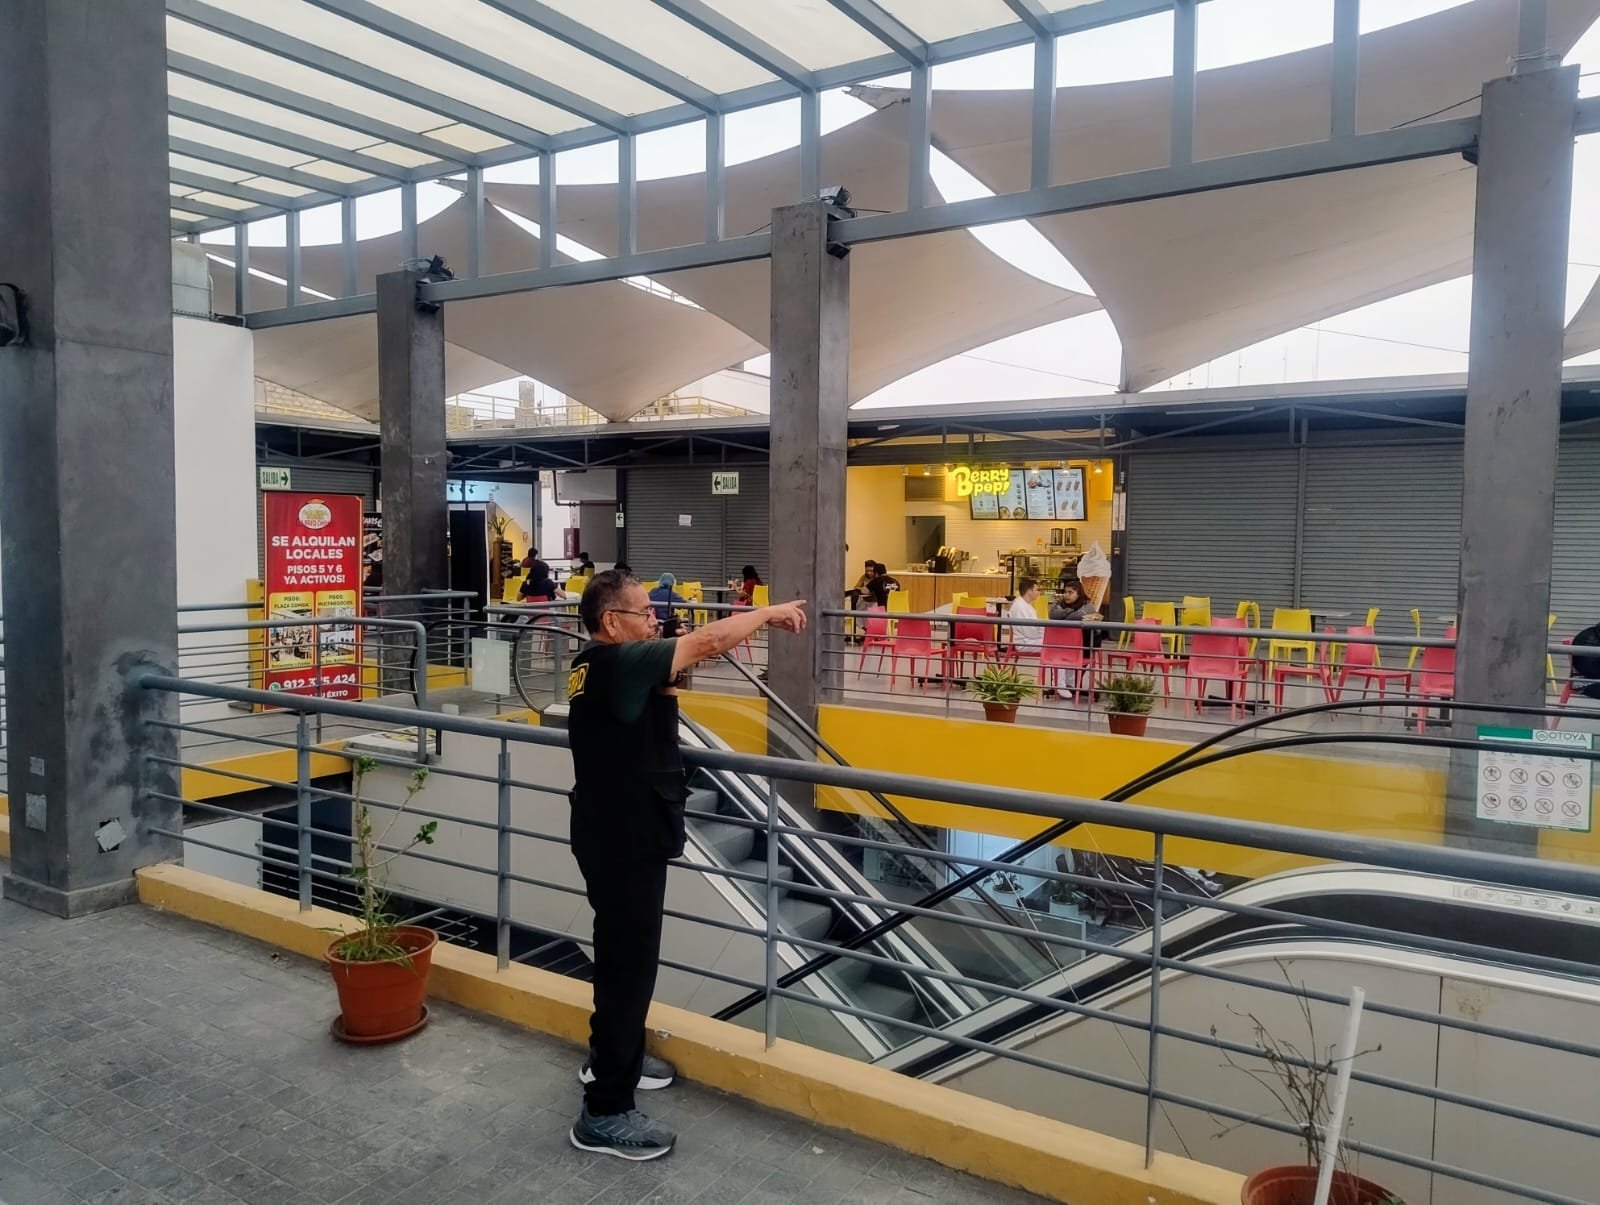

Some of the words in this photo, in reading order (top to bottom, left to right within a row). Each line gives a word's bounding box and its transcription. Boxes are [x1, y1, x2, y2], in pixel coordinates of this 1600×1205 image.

[262, 471, 279, 484] SALIDA
[722, 476, 737, 489] SALIDA
[271, 535, 289, 547] SE
[292, 535, 356, 547] ALQUILAN
[285, 548, 344, 560] LOCALES
[287, 565, 318, 574] PISOS
[318, 565, 325, 574] 5
[326, 565, 334, 573] Y
[335, 564, 343, 573] 6
[283, 575, 297, 585] YA
[300, 574, 346, 585] ACTIVOS!
[283, 678, 305, 689] 912
[332, 673, 356, 685] 424
